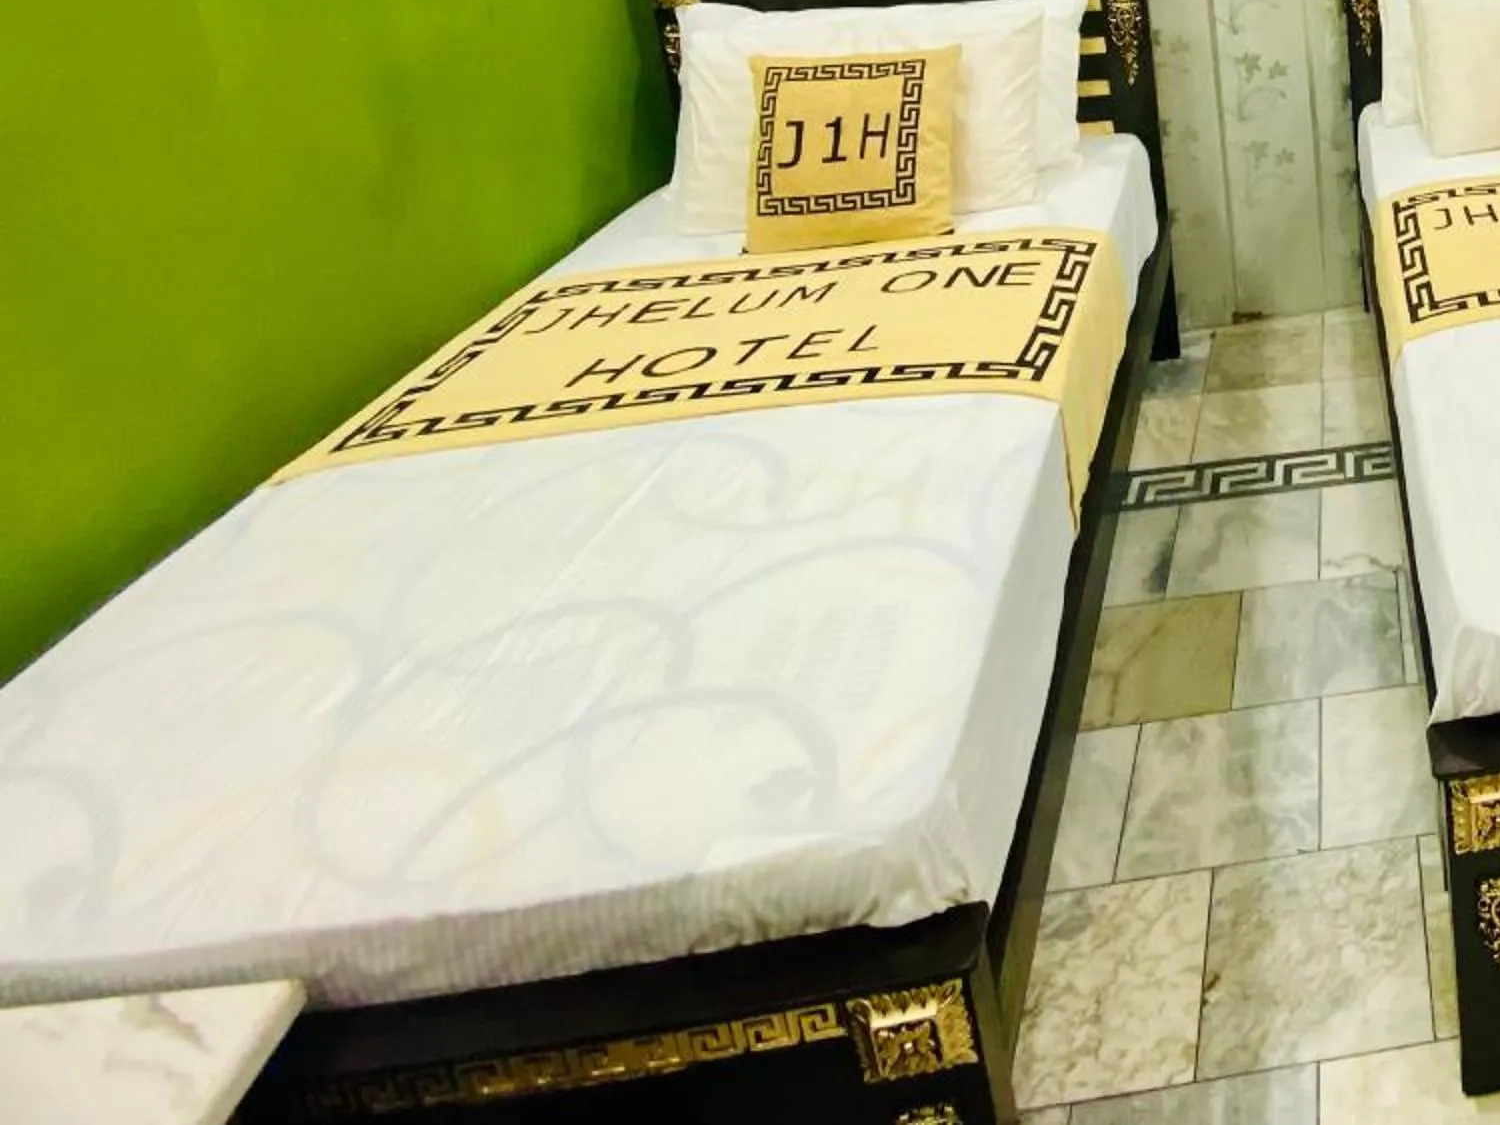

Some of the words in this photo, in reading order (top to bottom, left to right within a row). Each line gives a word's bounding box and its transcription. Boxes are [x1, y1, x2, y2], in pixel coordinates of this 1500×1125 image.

[526, 282, 833, 335] JHELUM
[882, 260, 1040, 295] ONE
[565, 326, 880, 387] HOTEL
